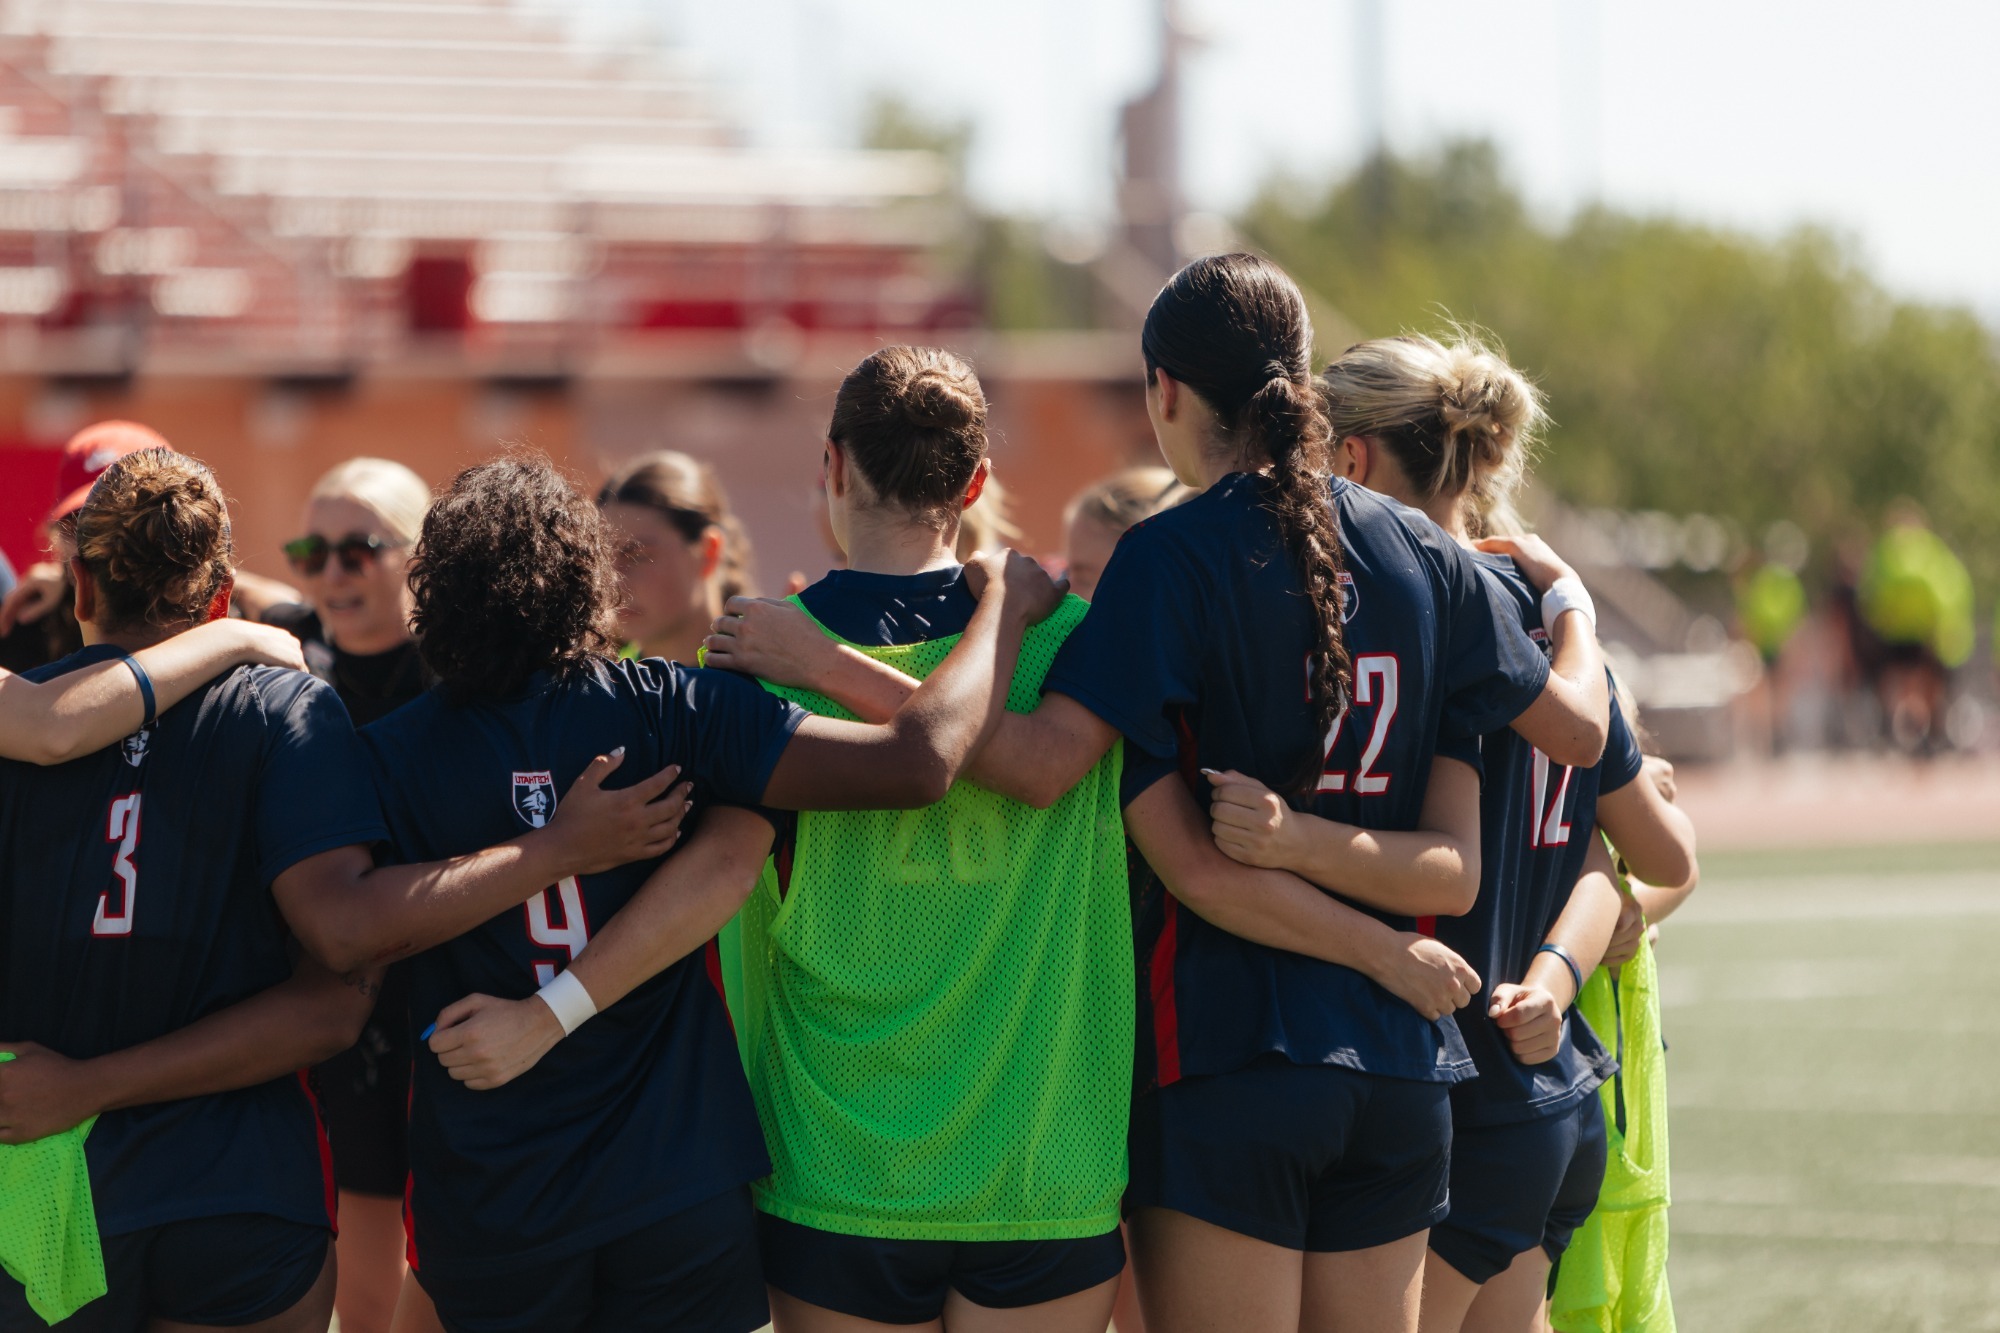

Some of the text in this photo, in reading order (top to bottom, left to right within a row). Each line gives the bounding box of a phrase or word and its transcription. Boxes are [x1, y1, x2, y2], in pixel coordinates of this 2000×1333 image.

[1305, 651, 1400, 796] 22
[90, 788, 142, 938] 3
[524, 875, 592, 988] 9
